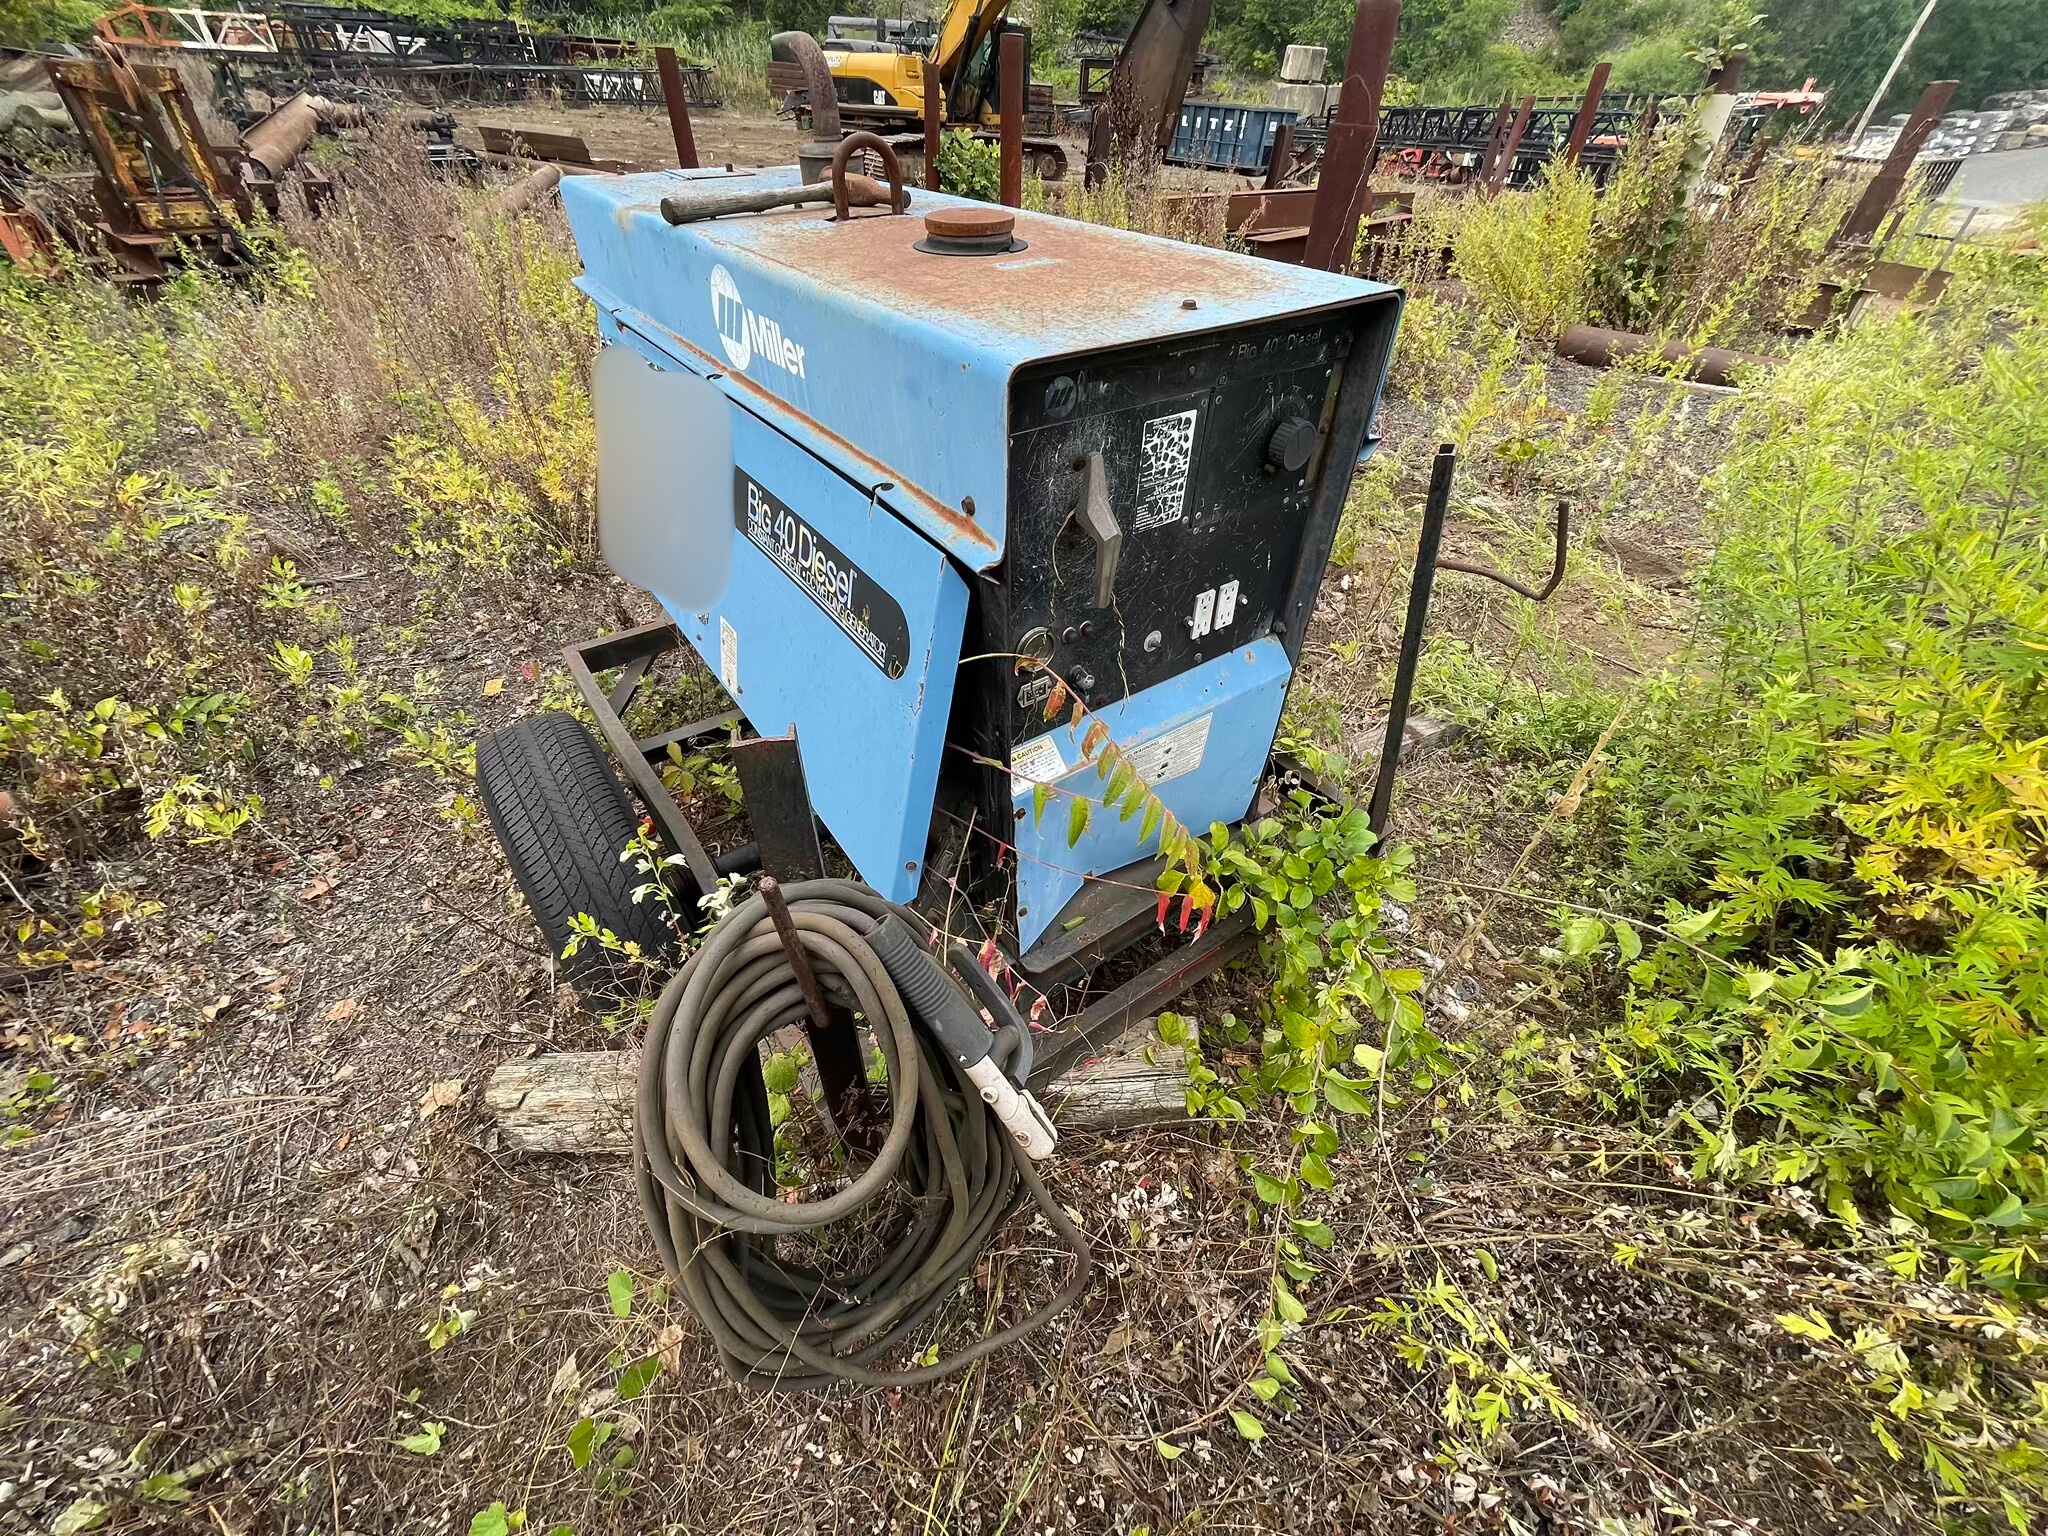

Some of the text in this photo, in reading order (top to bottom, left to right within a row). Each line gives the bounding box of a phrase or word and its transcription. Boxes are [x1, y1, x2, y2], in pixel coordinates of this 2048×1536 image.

[873, 90, 886, 105] CAT
[1181, 114, 1233, 132] LITZ
[747, 307, 805, 380] Miller
[1262, 337, 1279, 354] 40
[1286, 328, 1322, 350] Diesel
[774, 509, 796, 555] 40
[798, 523, 856, 609] Diesel
[747, 518, 775, 551] CONSTANT
[775, 542, 802, 576] CURRENT
[815, 577, 845, 618] WELDING
[845, 609, 887, 659] GENERATOR
[1016, 744, 1043, 761] CAUTION
